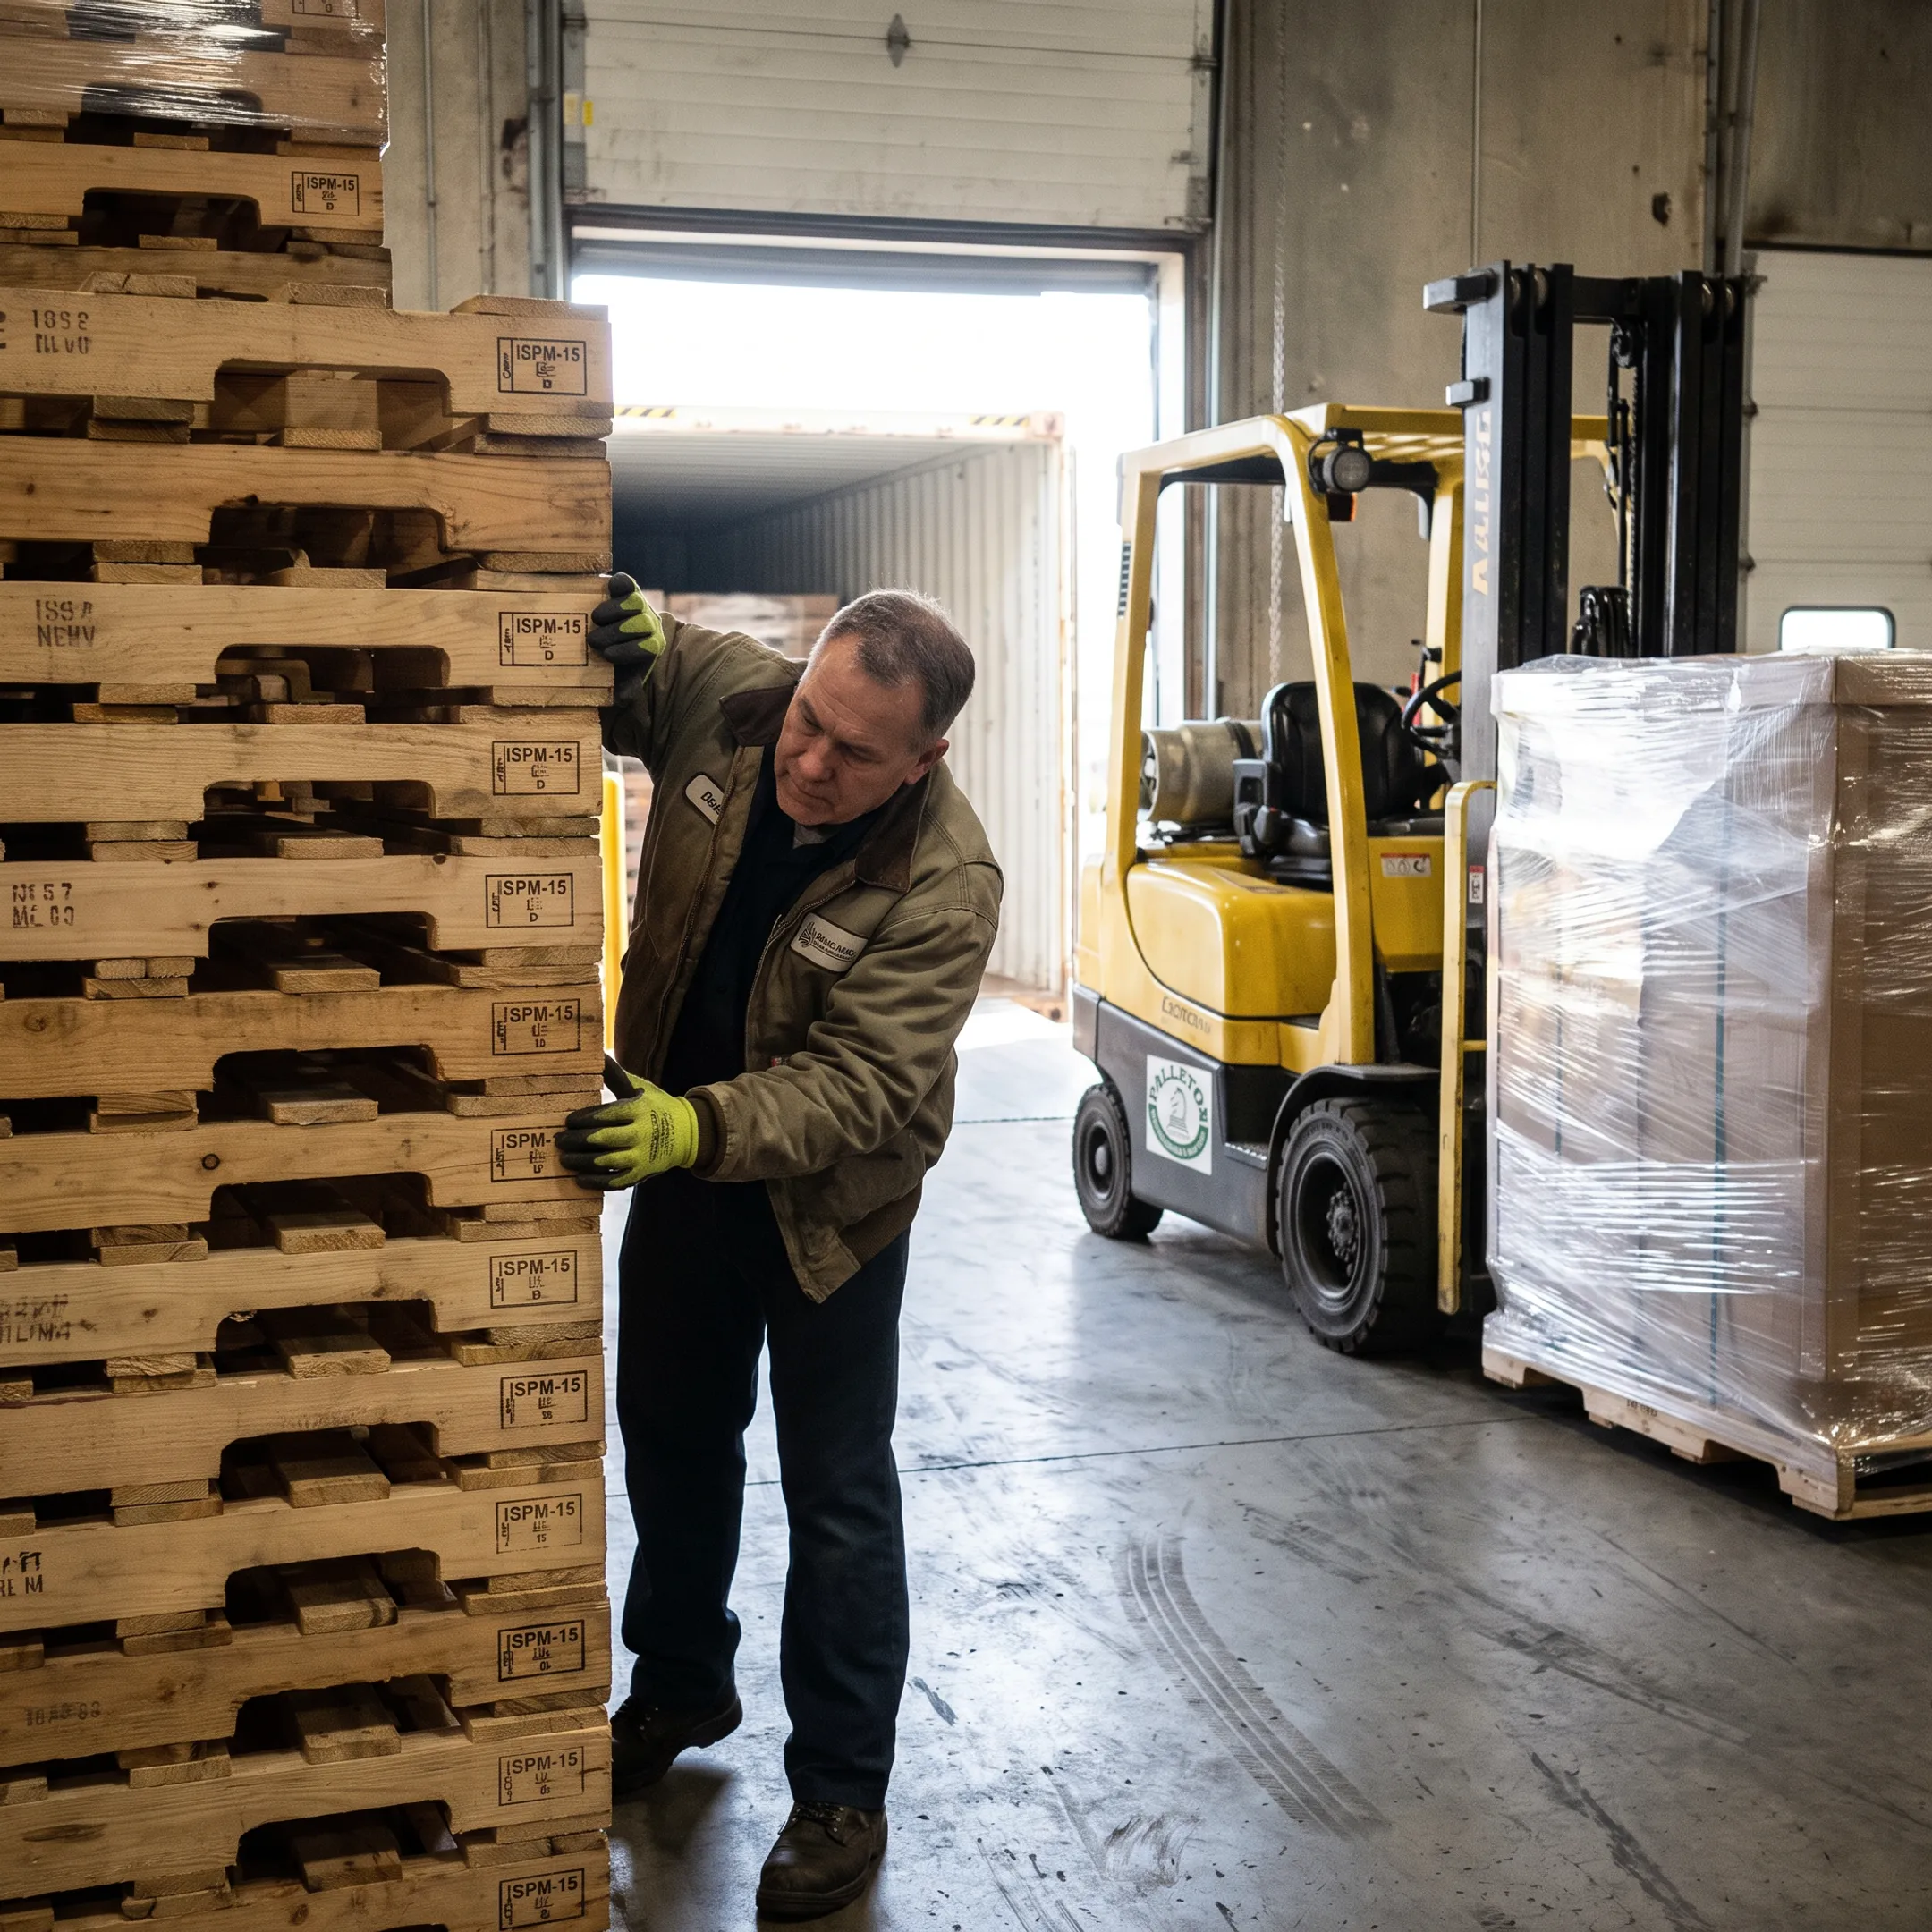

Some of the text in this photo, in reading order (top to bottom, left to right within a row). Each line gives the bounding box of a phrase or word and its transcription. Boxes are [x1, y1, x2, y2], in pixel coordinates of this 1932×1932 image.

[307, 177, 355, 191] ISPM-15
[516, 344, 580, 362] ISPM-15
[516, 618, 581, 634] ISPM-15
[545, 650, 554, 661] D
[506, 747, 573, 763] ISPM-15
[537, 780, 546, 790] D
[497, 880, 566, 895] ISPM-15
[530, 912, 538, 922] D
[504, 1005, 573, 1022] ISPM-15
[502, 1132, 556, 1149] ISPM-
[498, 1258, 570, 1277] ISPM-15
[510, 1377, 580, 1398] ISPM-15
[504, 1501, 575, 1521] ISPM-15
[537, 1533, 547, 1544] 15
[507, 1627, 579, 1648] ISPM-15
[507, 1751, 578, 1775] ISPM-15
[507, 1875, 578, 1899] ISPM-15
